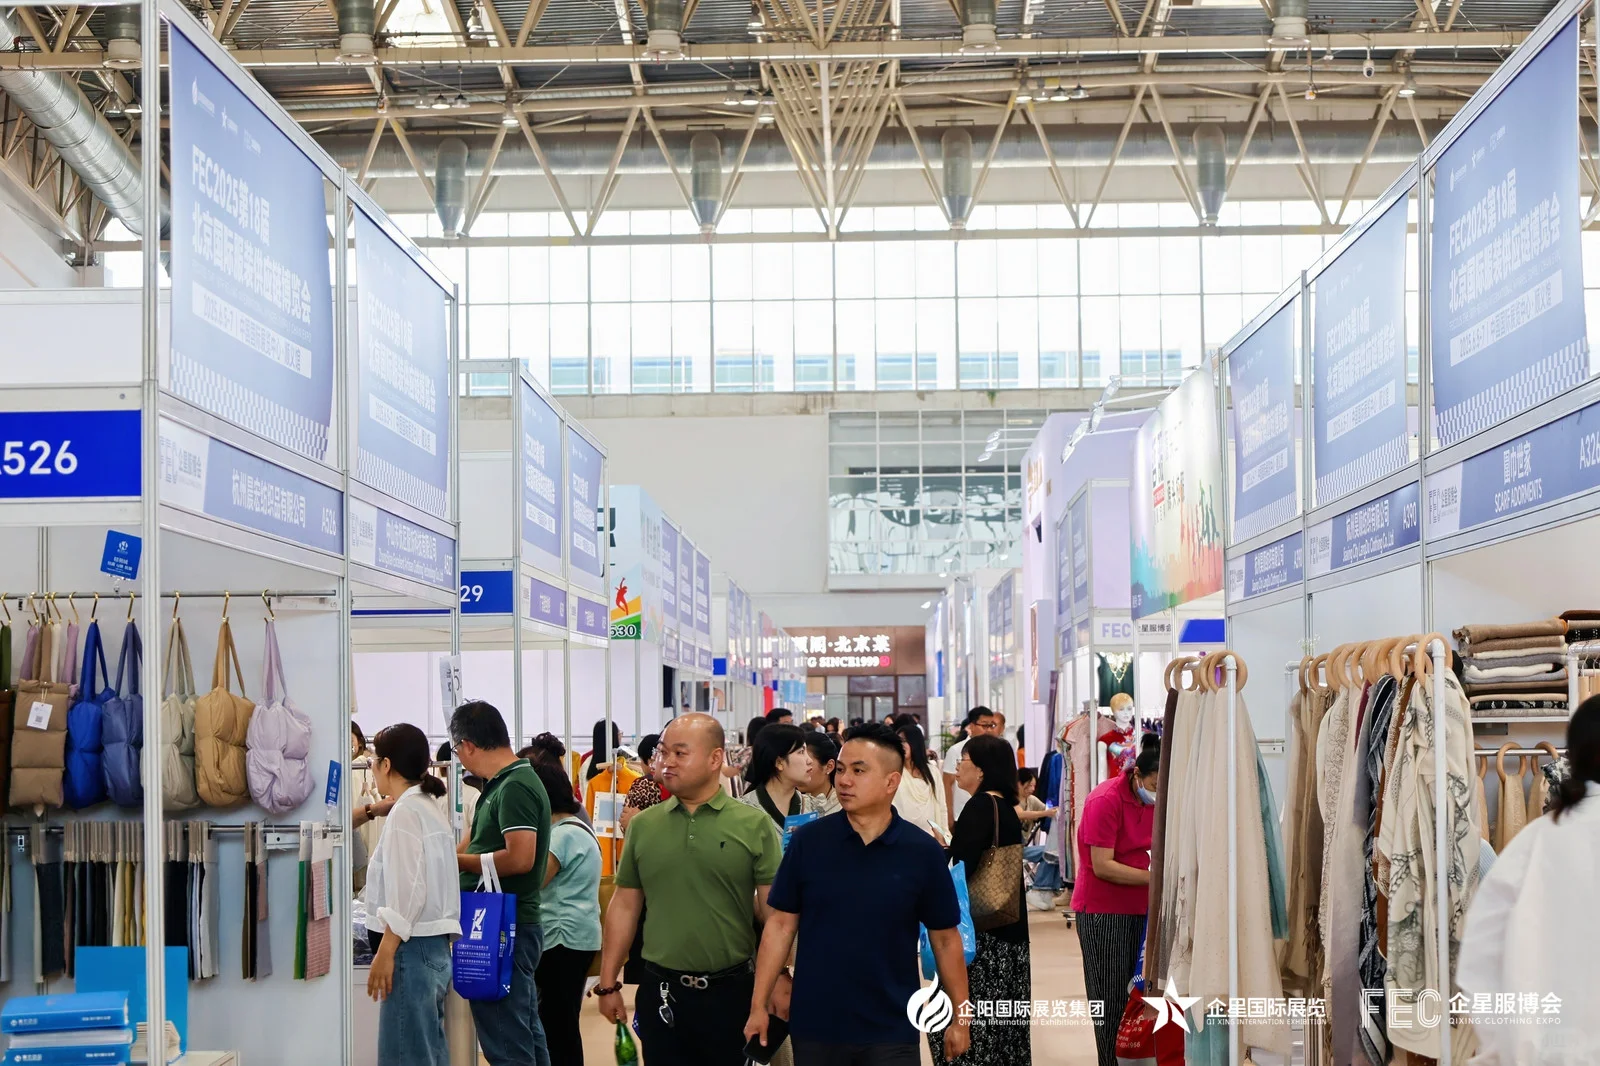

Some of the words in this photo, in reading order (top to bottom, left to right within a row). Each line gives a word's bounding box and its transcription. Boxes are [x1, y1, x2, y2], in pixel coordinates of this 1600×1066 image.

[192, 144, 270, 246] FEC2025第18届
[1449, 167, 1516, 259] FEC2025第18届
[0, 440, 78, 475] 526
[1101, 623, 1131, 638] FEC
[1138, 623, 1171, 633] 星服博会
